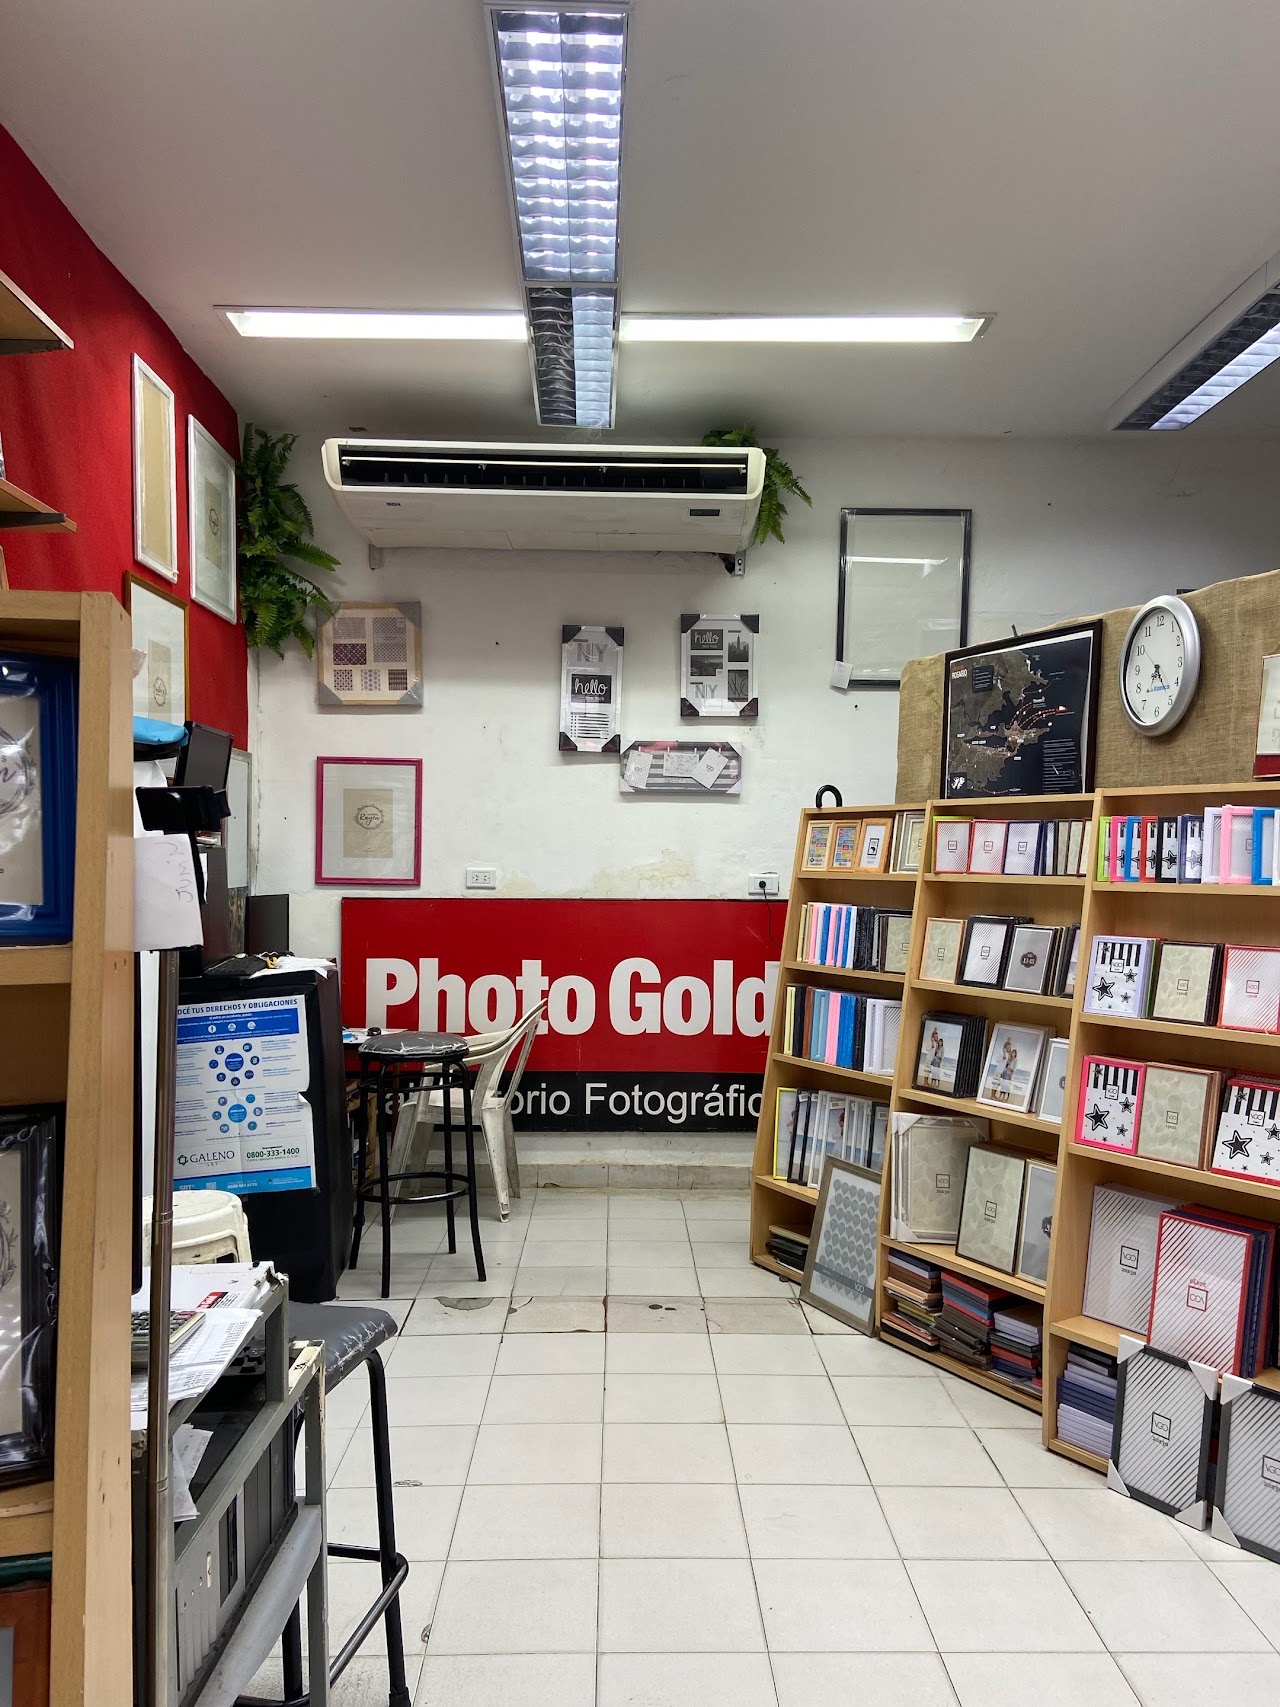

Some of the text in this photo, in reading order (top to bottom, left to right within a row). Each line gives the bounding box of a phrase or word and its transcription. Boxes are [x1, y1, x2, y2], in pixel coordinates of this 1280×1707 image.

[1156, 615, 1165, 627] 12
[1171, 621, 1175, 633] 1
[694, 631, 720, 644] hello
[1144, 626, 1152, 637] 11
[1176, 635, 1181, 647] 2
[1136, 645, 1145, 656] 10
[1177, 656, 1183, 667] 3
[1135, 664, 1140, 676] 9
[574, 678, 608, 695] hello
[1174, 677, 1179, 686] 4
[694, 684, 718, 699] NY
[1136, 683, 1141, 694] 8
[1141, 699, 1146, 710] 7
[1167, 695, 1173, 705] 5
[1154, 706, 1160, 717] 6
[365, 957, 596, 1035] Photo
[192, 1006, 204, 1014] TUS
[205, 1003, 241, 1013] DERECHOS
[248, 999, 298, 1009] OBLIGACIONES
[189, 1150, 235, 1164] GALENO
[246, 1147, 300, 1159] 0800-333-1400
[1122, 1251, 1137, 1262] VGO
[1154, 1420, 1168, 1432] VGO
[1152, 1436, 1169, 1447] 20x30
